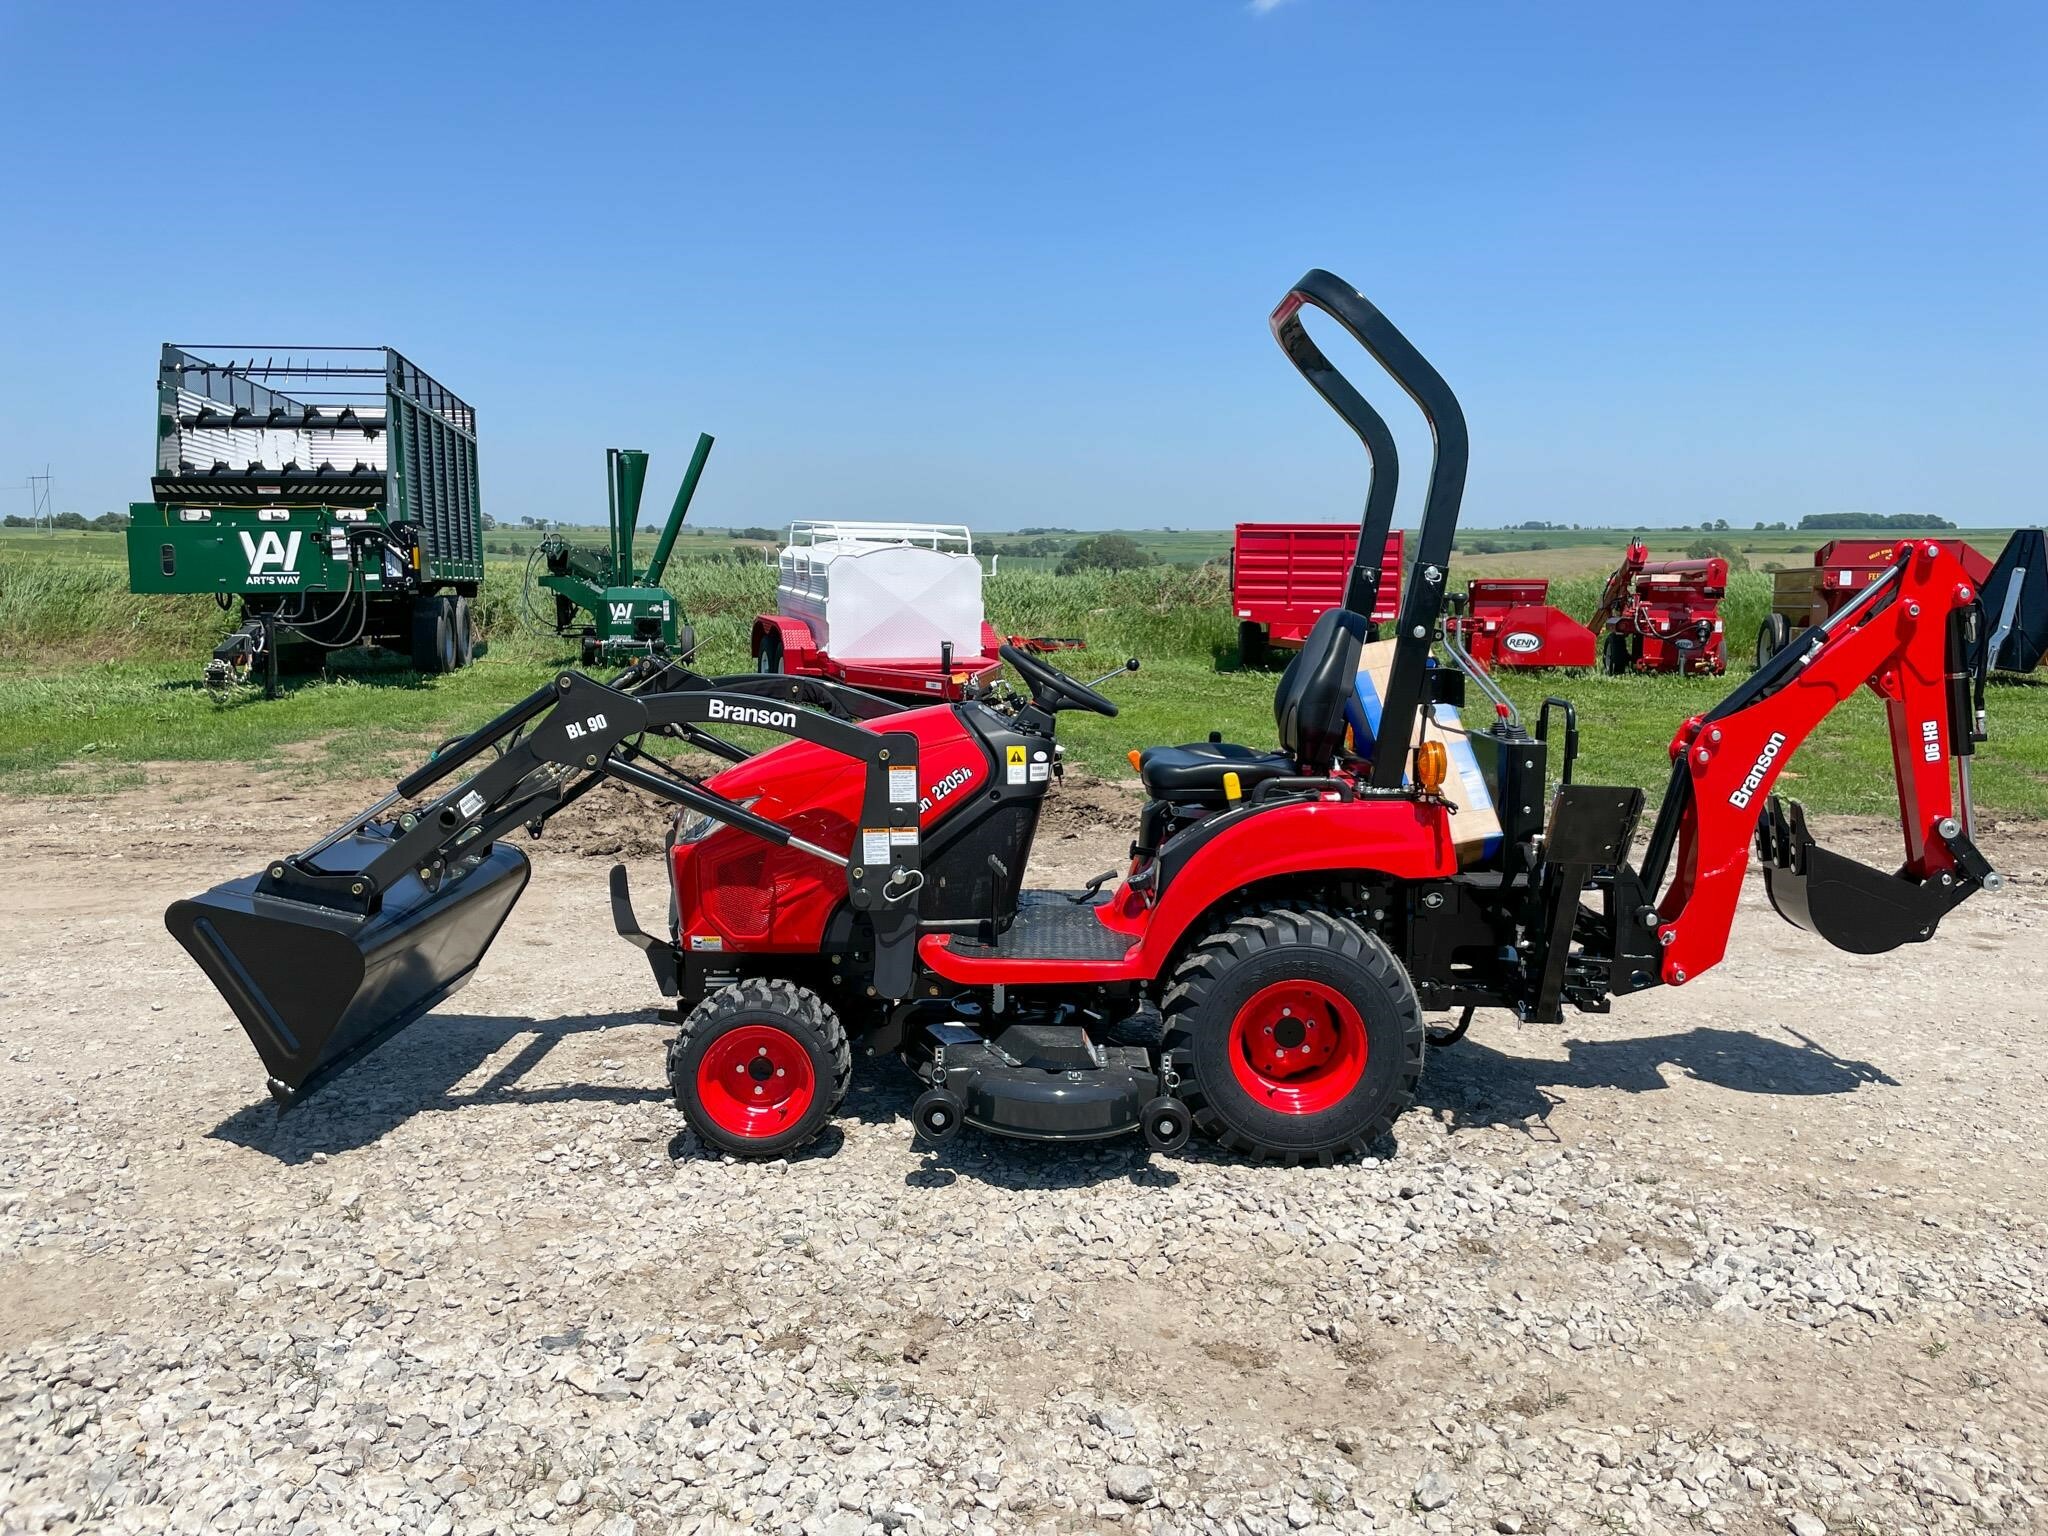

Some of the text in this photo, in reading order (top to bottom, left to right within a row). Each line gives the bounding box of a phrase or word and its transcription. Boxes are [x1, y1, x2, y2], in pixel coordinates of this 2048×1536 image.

[246, 576, 300, 584] ART'S WAY
[1508, 637, 1538, 648] RENN
[565, 713, 608, 740] BL 90
[708, 697, 797, 728] Branson
[1922, 720, 1941, 762] BH 90
[931, 767, 973, 801] 2205h
[1729, 731, 1787, 809] Branson
